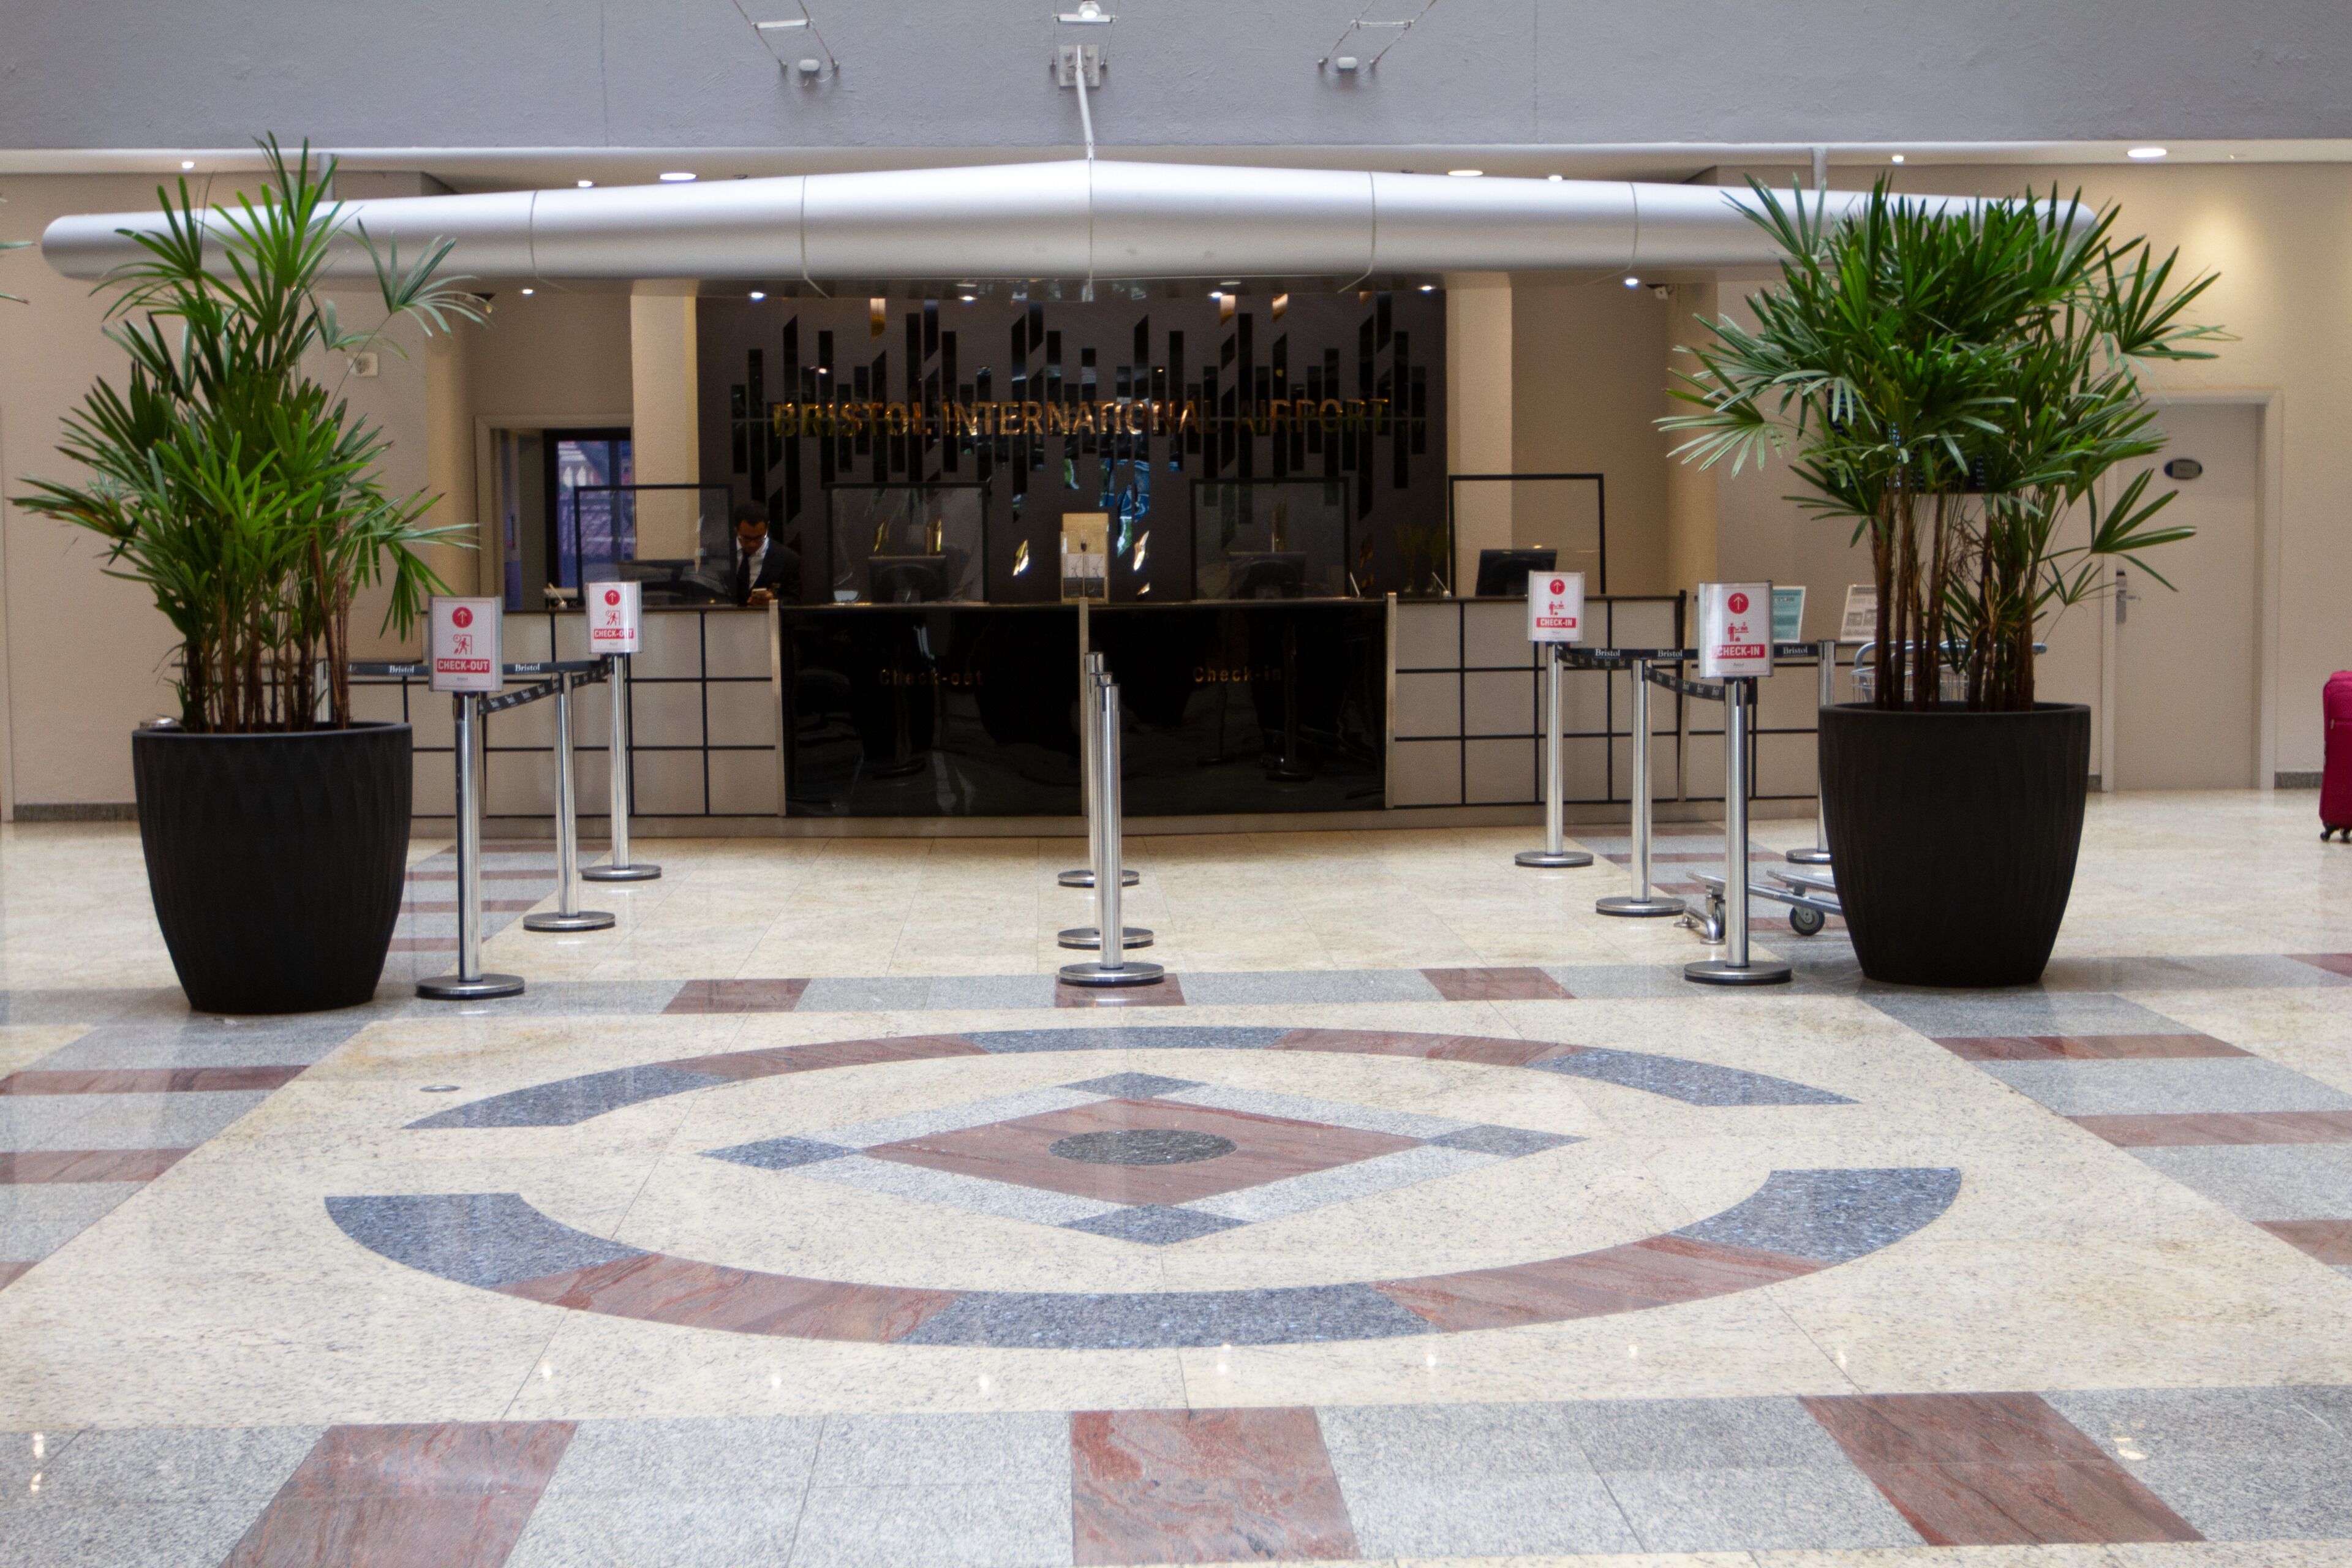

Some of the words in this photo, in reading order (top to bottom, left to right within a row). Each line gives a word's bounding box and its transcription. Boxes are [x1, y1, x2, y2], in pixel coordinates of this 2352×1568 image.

[774, 402, 932, 437] BRISTOL
[943, 401, 1222, 436] INTERNATIONAL
[1235, 399, 1389, 434] AIRPORT
[1595, 648, 1621, 657] Bristol
[1716, 646, 1760, 656] CHECK-IN
[1783, 646, 1807, 654] Bristol
[438, 660, 489, 671] CHECK-OUT
[514, 663, 540, 672] Bristol
[1193, 665, 1281, 682] Check-in
